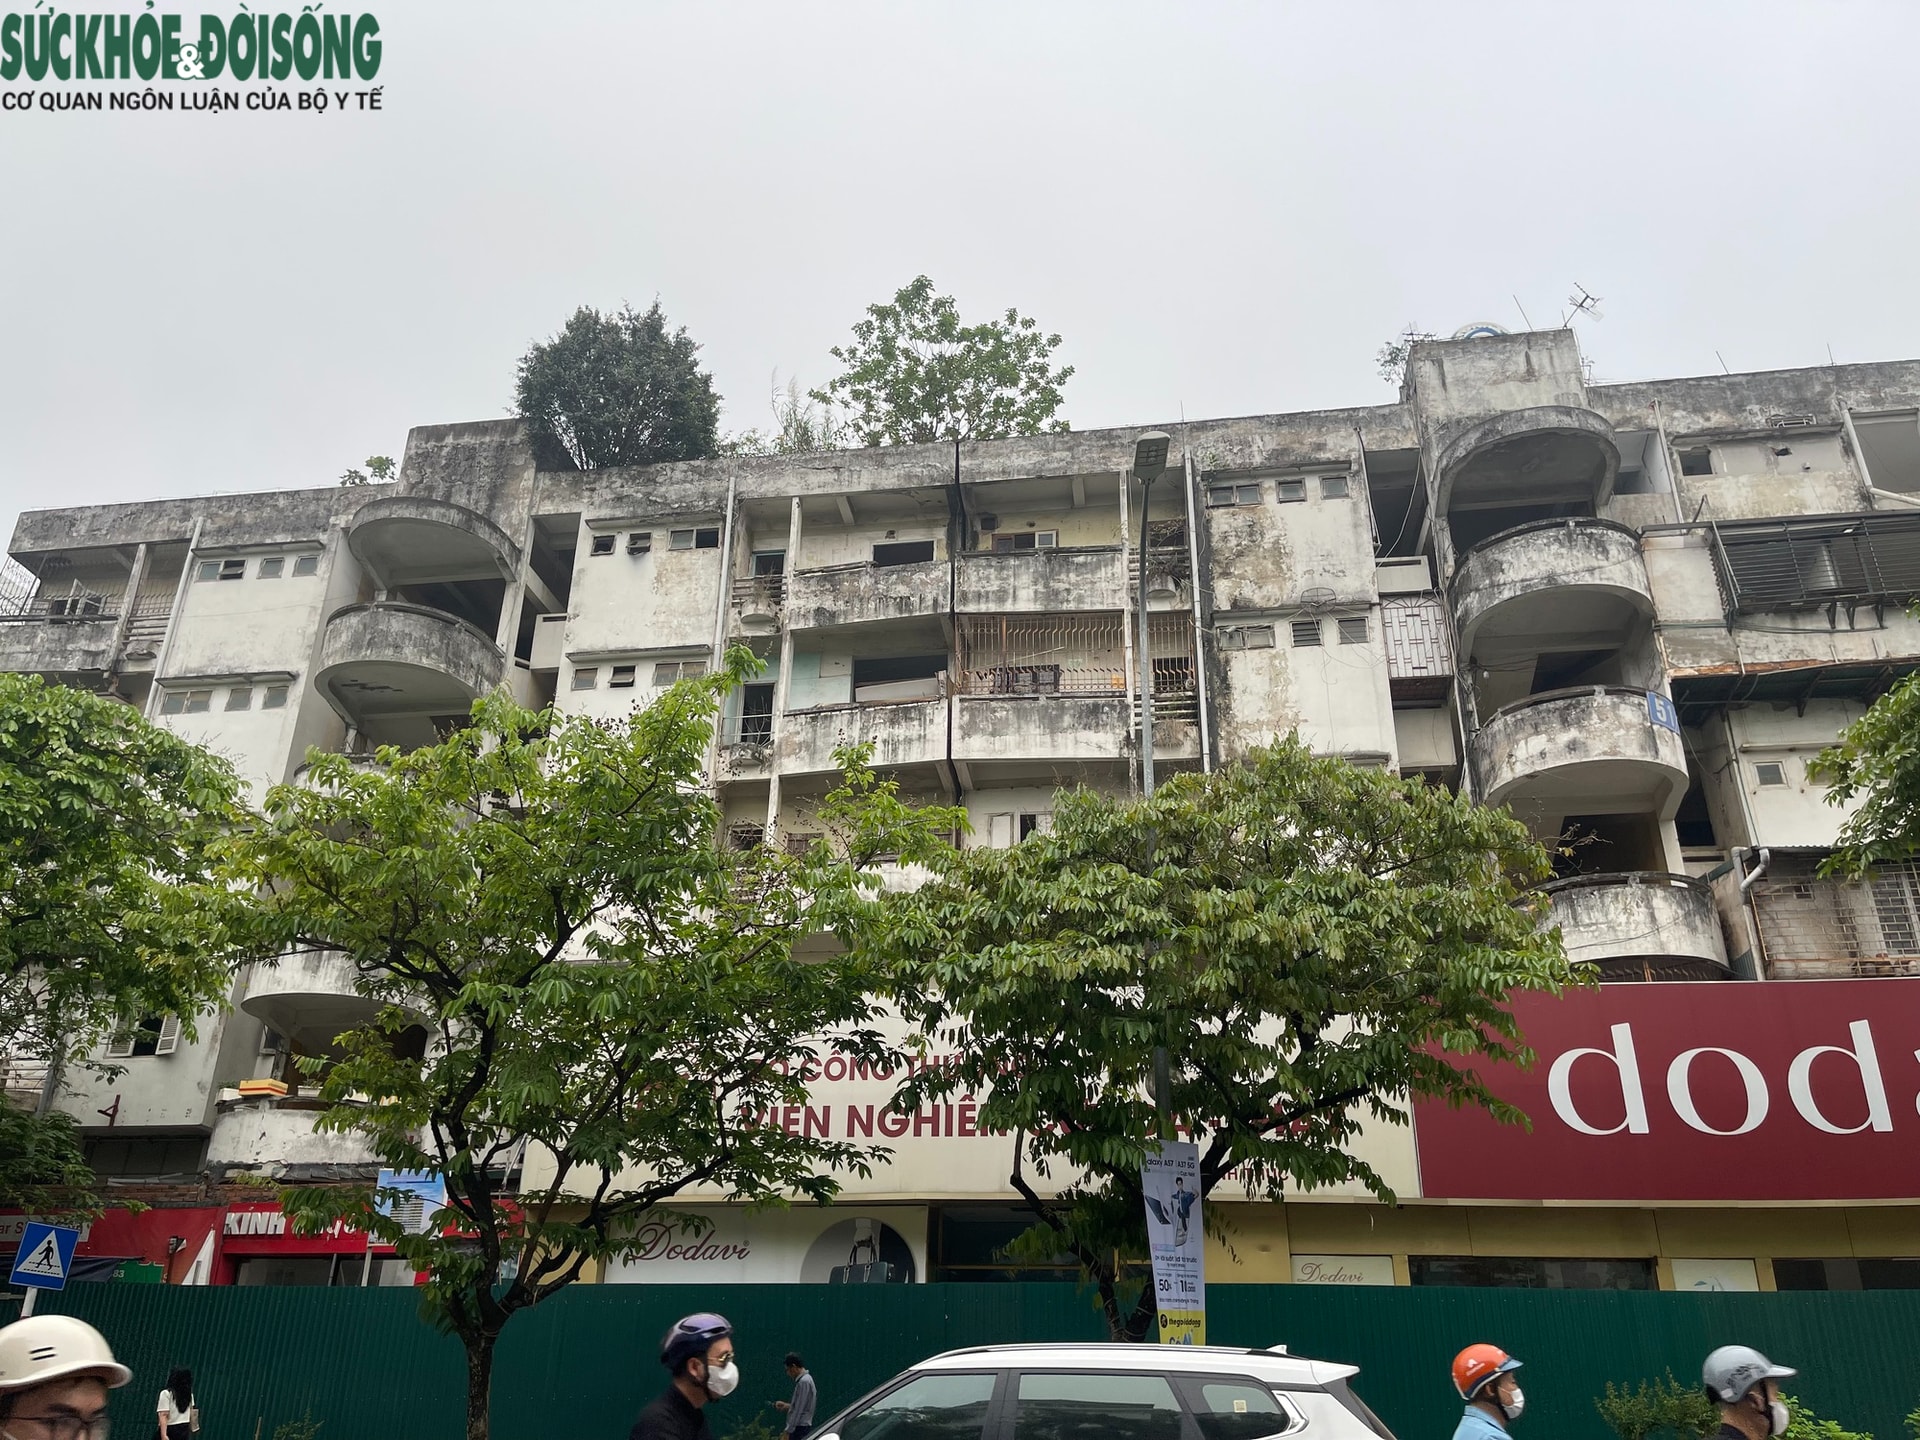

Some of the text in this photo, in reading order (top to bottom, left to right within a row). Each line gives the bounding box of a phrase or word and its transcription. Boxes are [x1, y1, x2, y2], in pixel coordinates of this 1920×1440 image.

[1654, 696, 1675, 728] 51
[801, 1050, 895, 1082] CÔNG
[1547, 1019, 1920, 1136] dod
[223, 1206, 287, 1235] KÍNH
[629, 1222, 750, 1261] Dodavi
[1297, 1262, 1364, 1282] Dodavi
